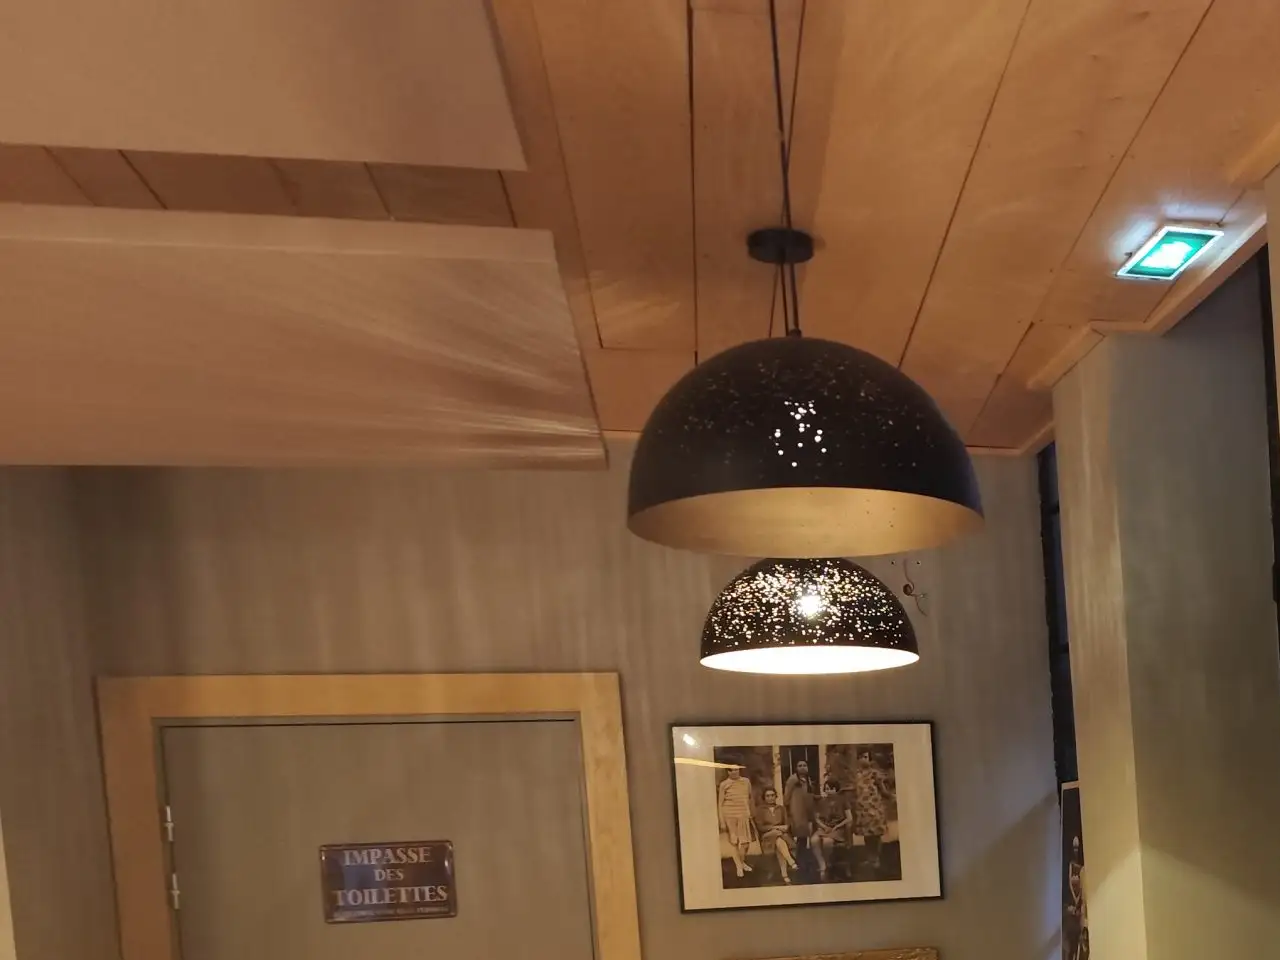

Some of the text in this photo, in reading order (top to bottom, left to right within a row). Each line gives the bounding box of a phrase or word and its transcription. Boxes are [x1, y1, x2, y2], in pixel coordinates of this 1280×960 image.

[343, 847, 433, 865] IMPASSE
[374, 868, 405, 881] DES
[331, 885, 448, 906] TOILETTES
